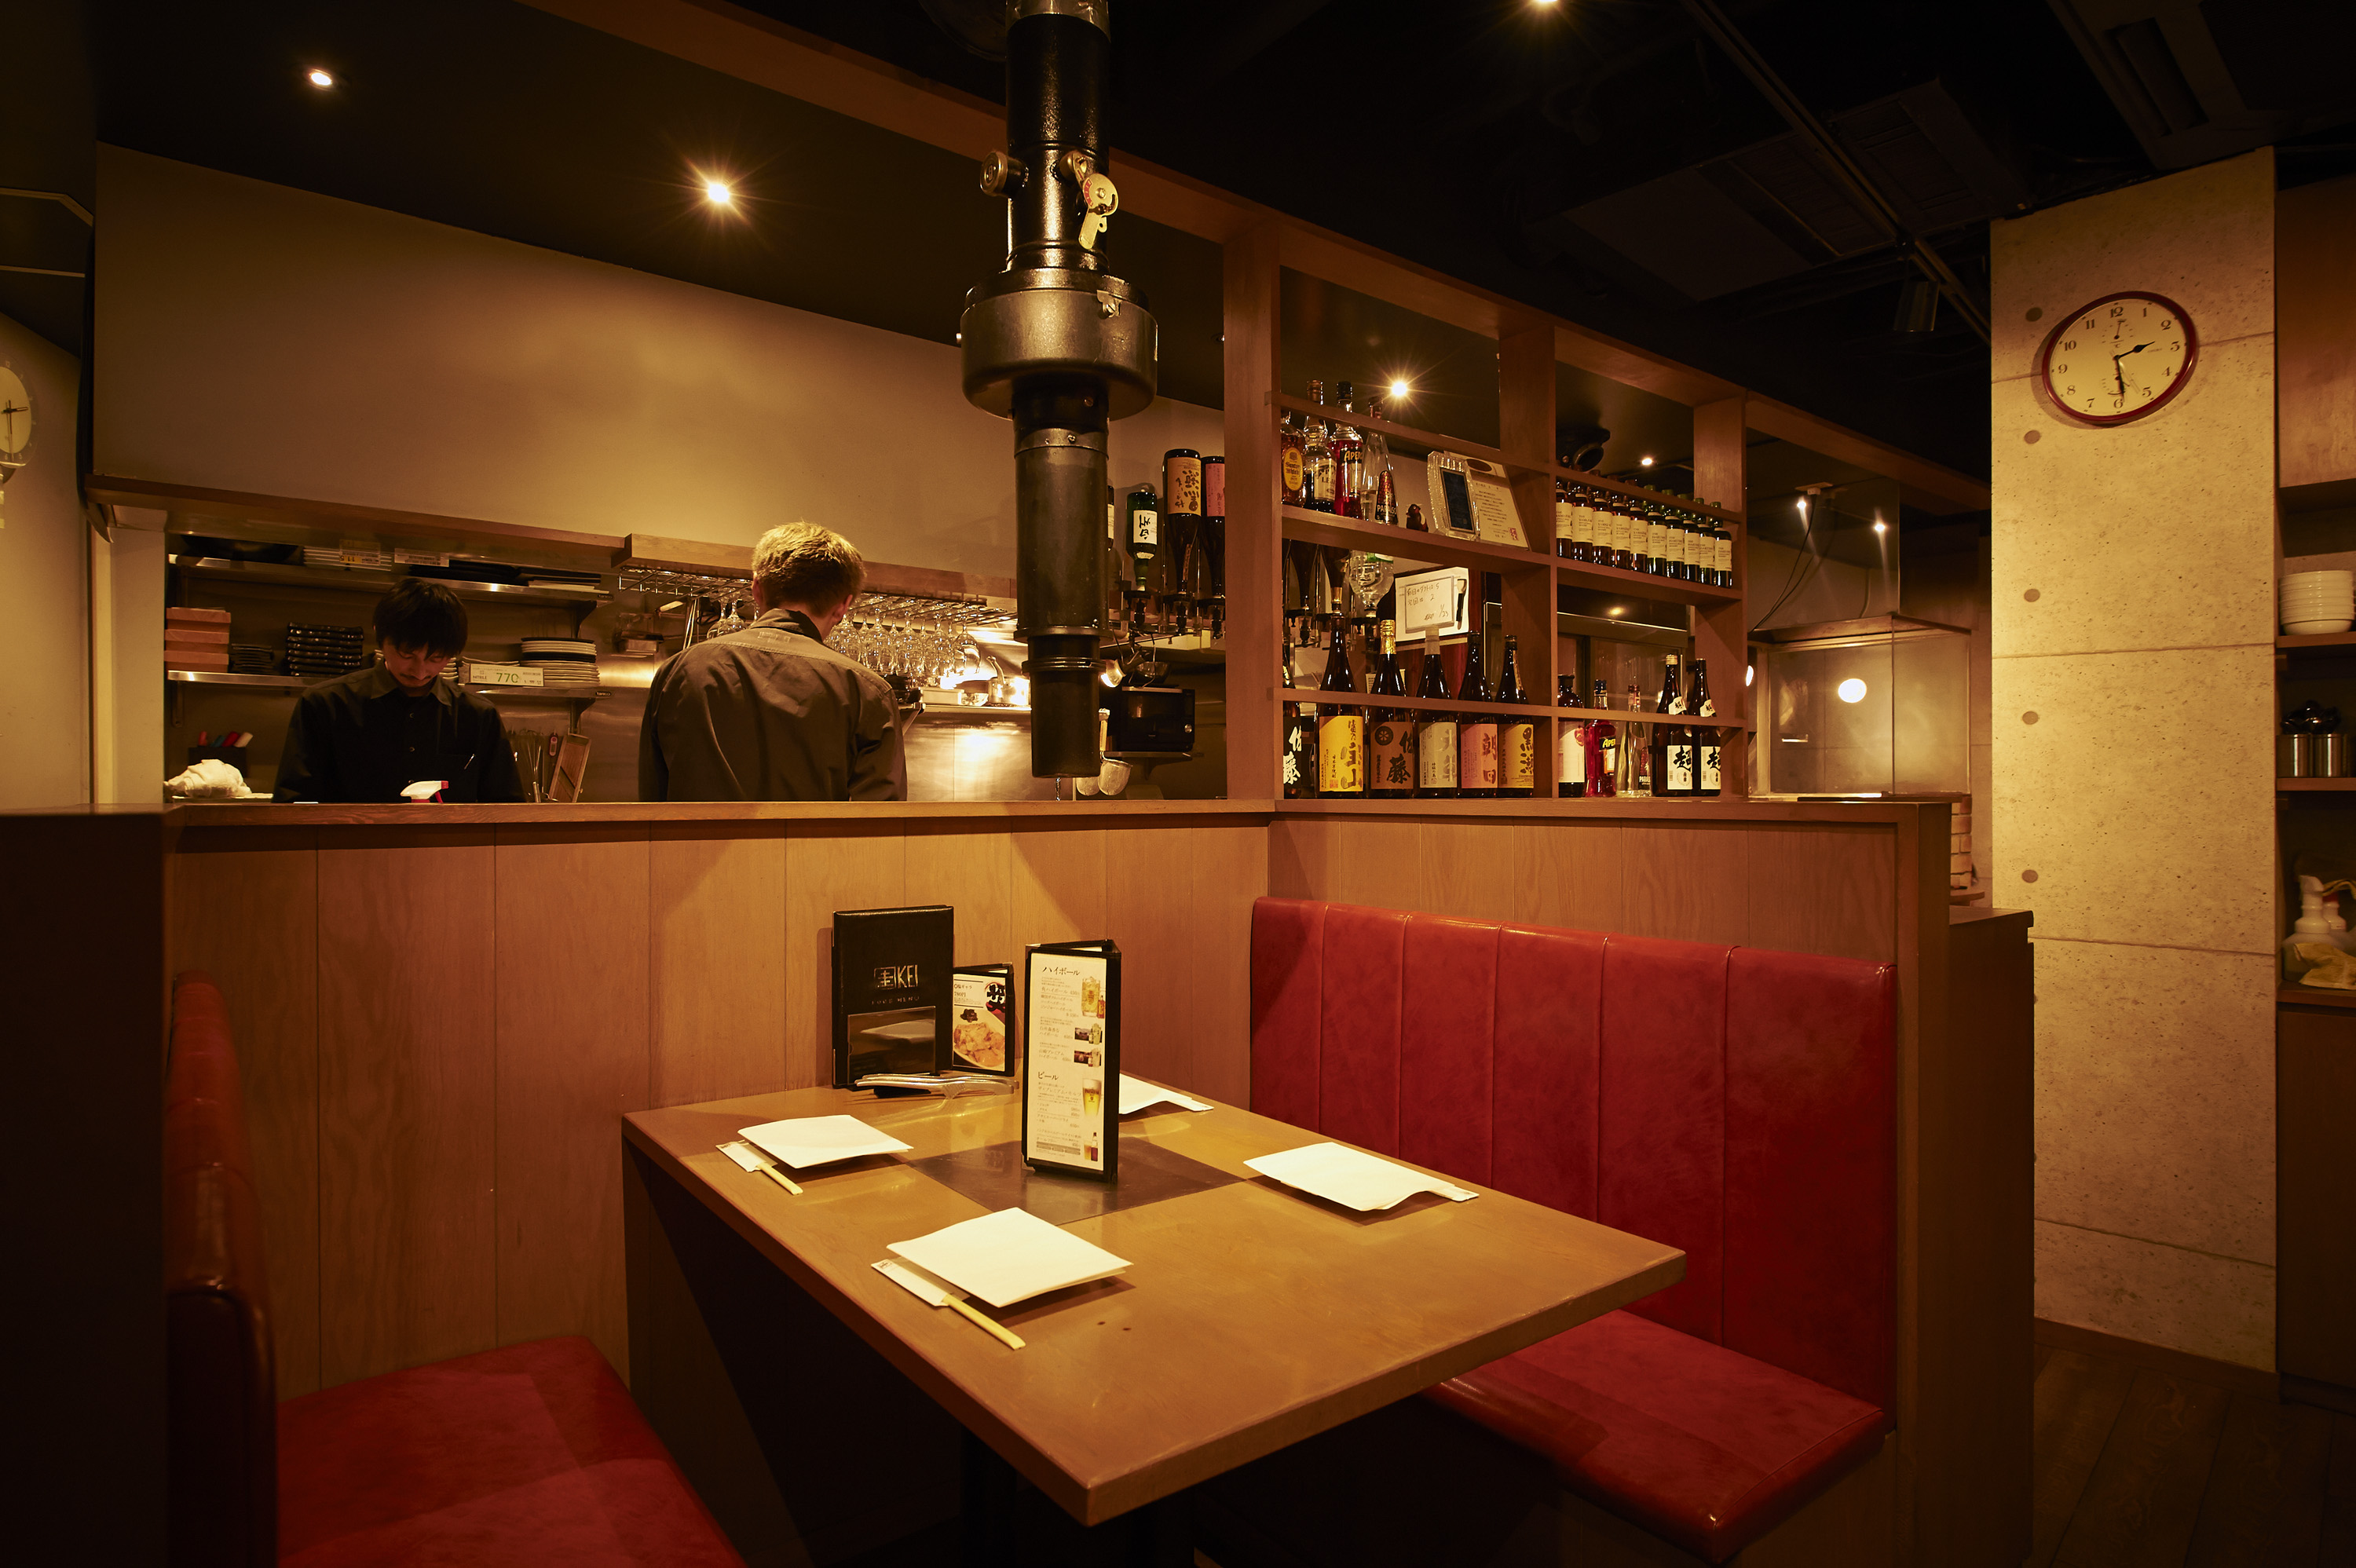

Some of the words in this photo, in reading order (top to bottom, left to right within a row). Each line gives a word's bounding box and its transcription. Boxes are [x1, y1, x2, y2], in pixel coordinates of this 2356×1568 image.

[2110, 306, 2124, 319] 12
[2142, 308, 2148, 318] 1
[2086, 319, 2096, 330] 11
[2161, 320, 2171, 331] 2
[2064, 340, 2077, 351] 10
[2170, 341, 2180, 352] 3
[2058, 364, 2068, 374] 9
[2161, 367, 2171, 377] 4
[2067, 385, 2076, 396] 8
[2142, 386, 2153, 397] 5
[2087, 398, 2095, 408] 7
[2113, 398, 2124, 409] 6
[1139, 514, 1151, 540] 白州
[496, 672, 519, 683] 770
[1603, 738, 1615, 748] APE
[1386, 730, 1414, 784] 佐藤
[897, 965, 918, 989] KEI
[1042, 967, 1081, 976] ハイボール
[1037, 1071, 1059, 1080] ビール
